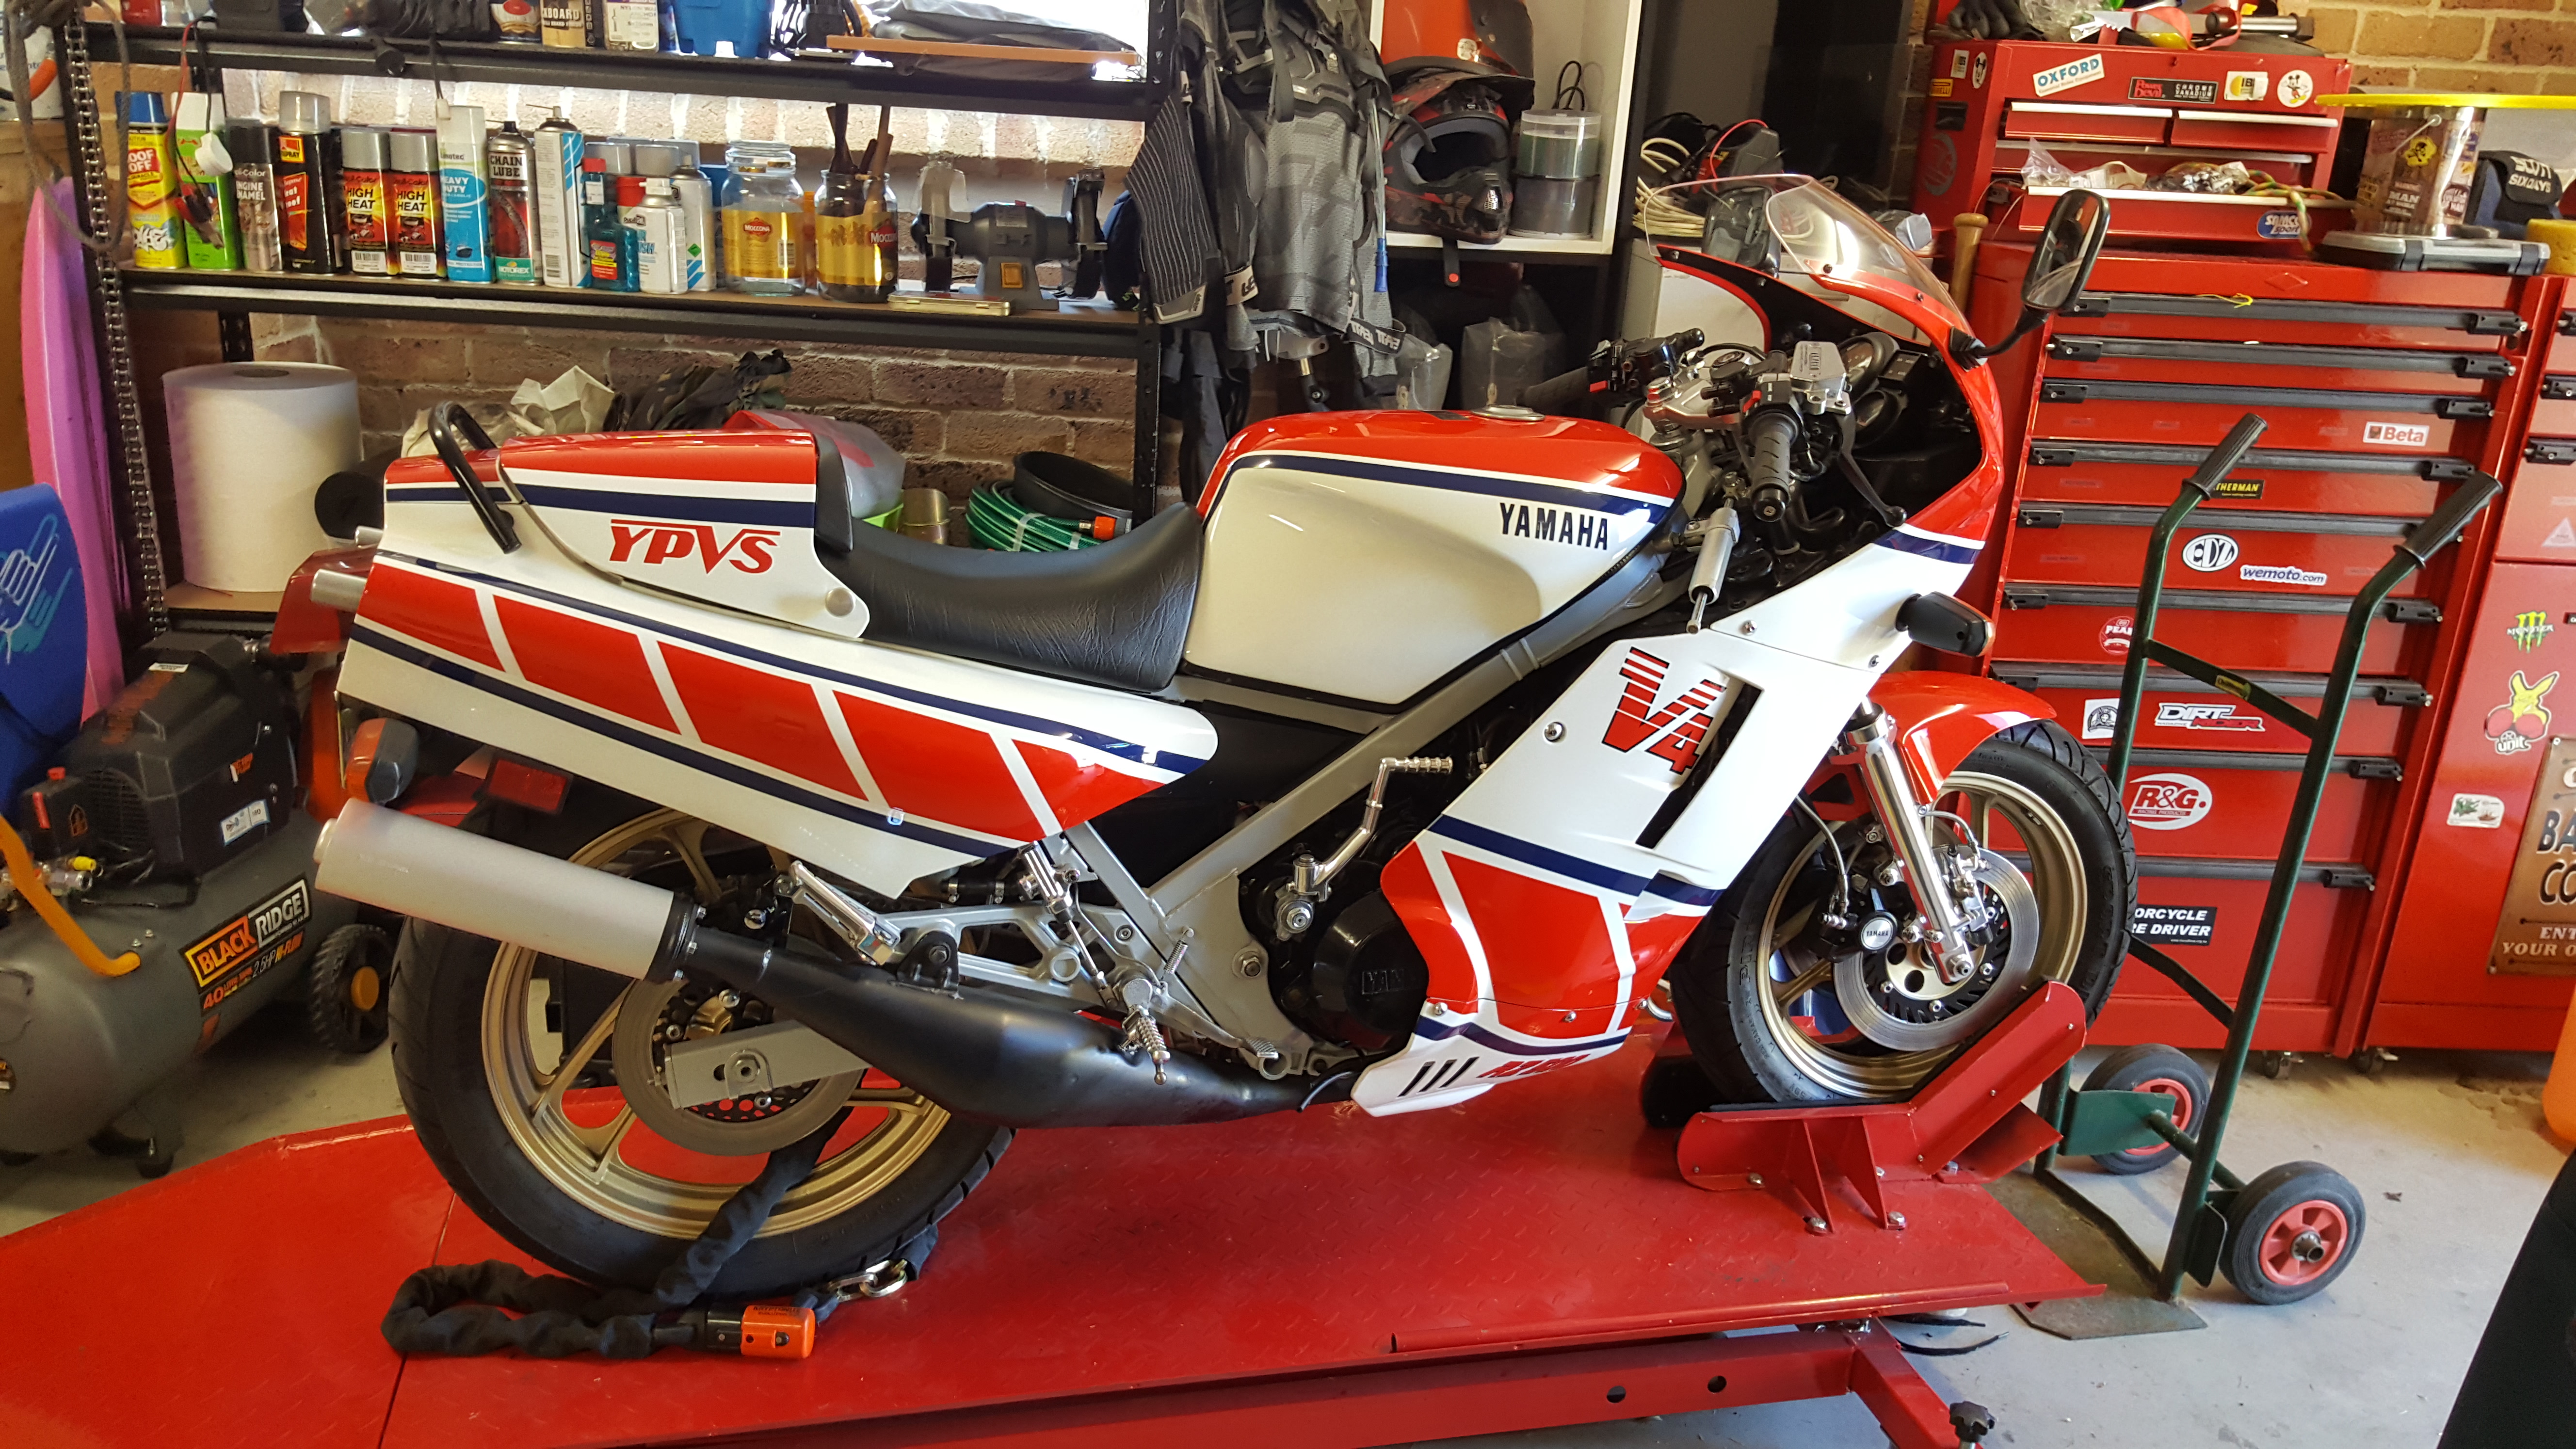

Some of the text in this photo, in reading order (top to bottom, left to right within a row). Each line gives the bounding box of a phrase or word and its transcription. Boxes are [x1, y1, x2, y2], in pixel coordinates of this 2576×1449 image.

[2037, 58, 2099, 86] OXFORD
[490, 155, 522, 166] CHAIN
[493, 166, 520, 177] LUBE
[347, 187, 373, 198] HIGH
[397, 191, 425, 200] HIGH
[347, 199, 376, 209] HEAT
[398, 201, 427, 211] HEAT
[2383, 426, 2424, 442] Beta
[1500, 502, 1608, 550] YAMAHA
[609, 519, 781, 575] YPVS
[2242, 568, 2323, 582] wemoto.com
[2158, 706, 2232, 721] DIRT
[2498, 735, 2525, 752] unit
[2135, 788, 2199, 809] R&G
[197, 929, 257, 975] BLACK
[255, 892, 303, 936] RIDGE
[2150, 923, 2212, 936] DRIVER
[2502, 942, 2557, 956] YOUR
[204, 986, 225, 1010] 40
